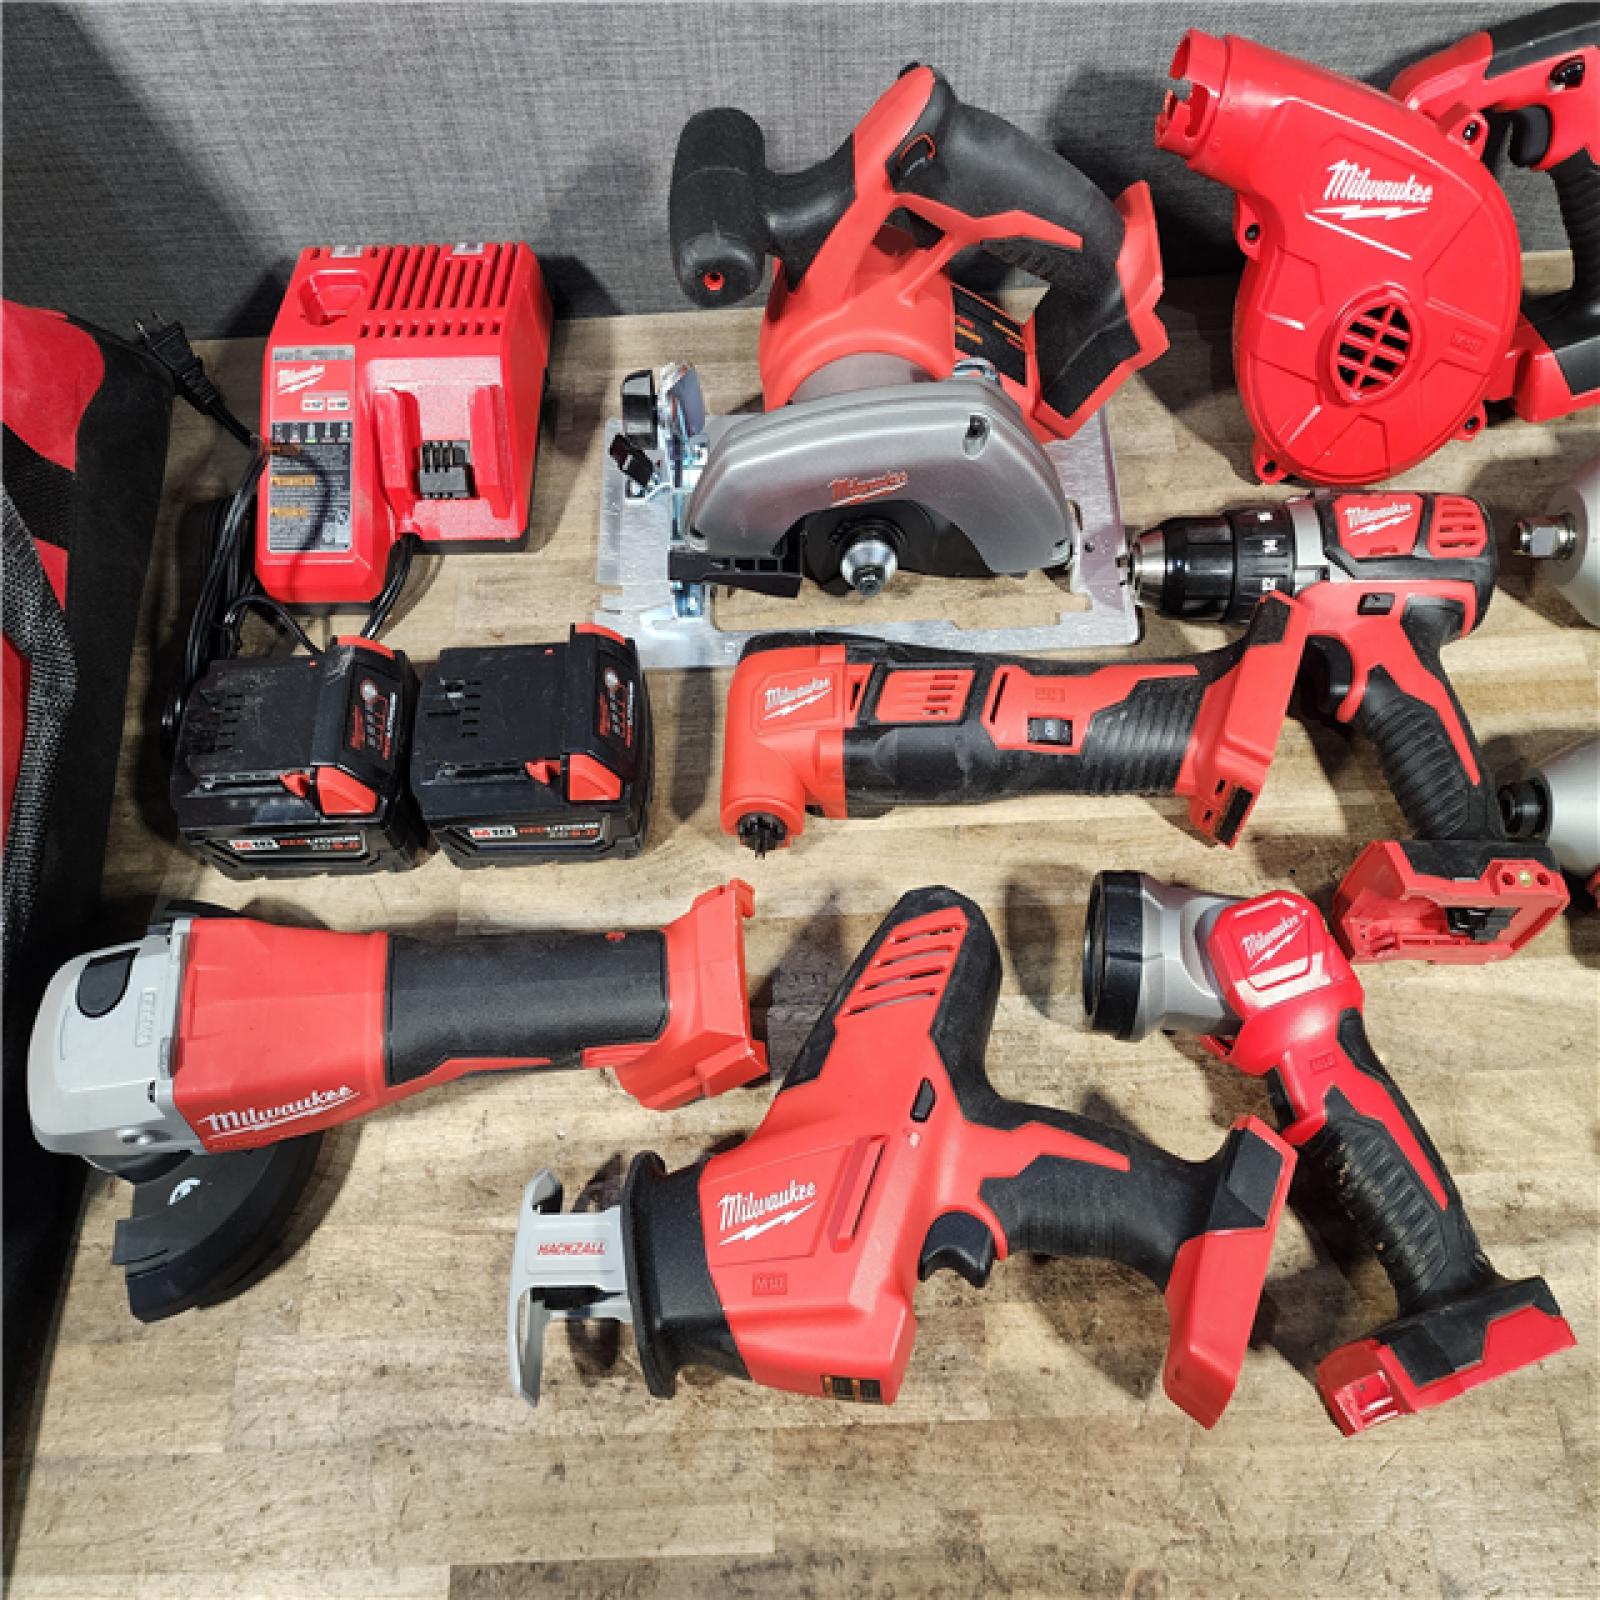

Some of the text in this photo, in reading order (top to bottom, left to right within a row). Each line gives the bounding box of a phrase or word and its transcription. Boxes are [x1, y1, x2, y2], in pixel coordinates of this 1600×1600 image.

[1324, 158, 1433, 203] Milwaukee
[1344, 502, 1413, 529] Milwaukee
[765, 677, 831, 711] Milwaukee
[1241, 915, 1299, 960] Milwaukee
[198, 1084, 354, 1131] Milwaukee
[717, 1179, 817, 1232] Milwaukee
[537, 1240, 606, 1256] HACKZALL
